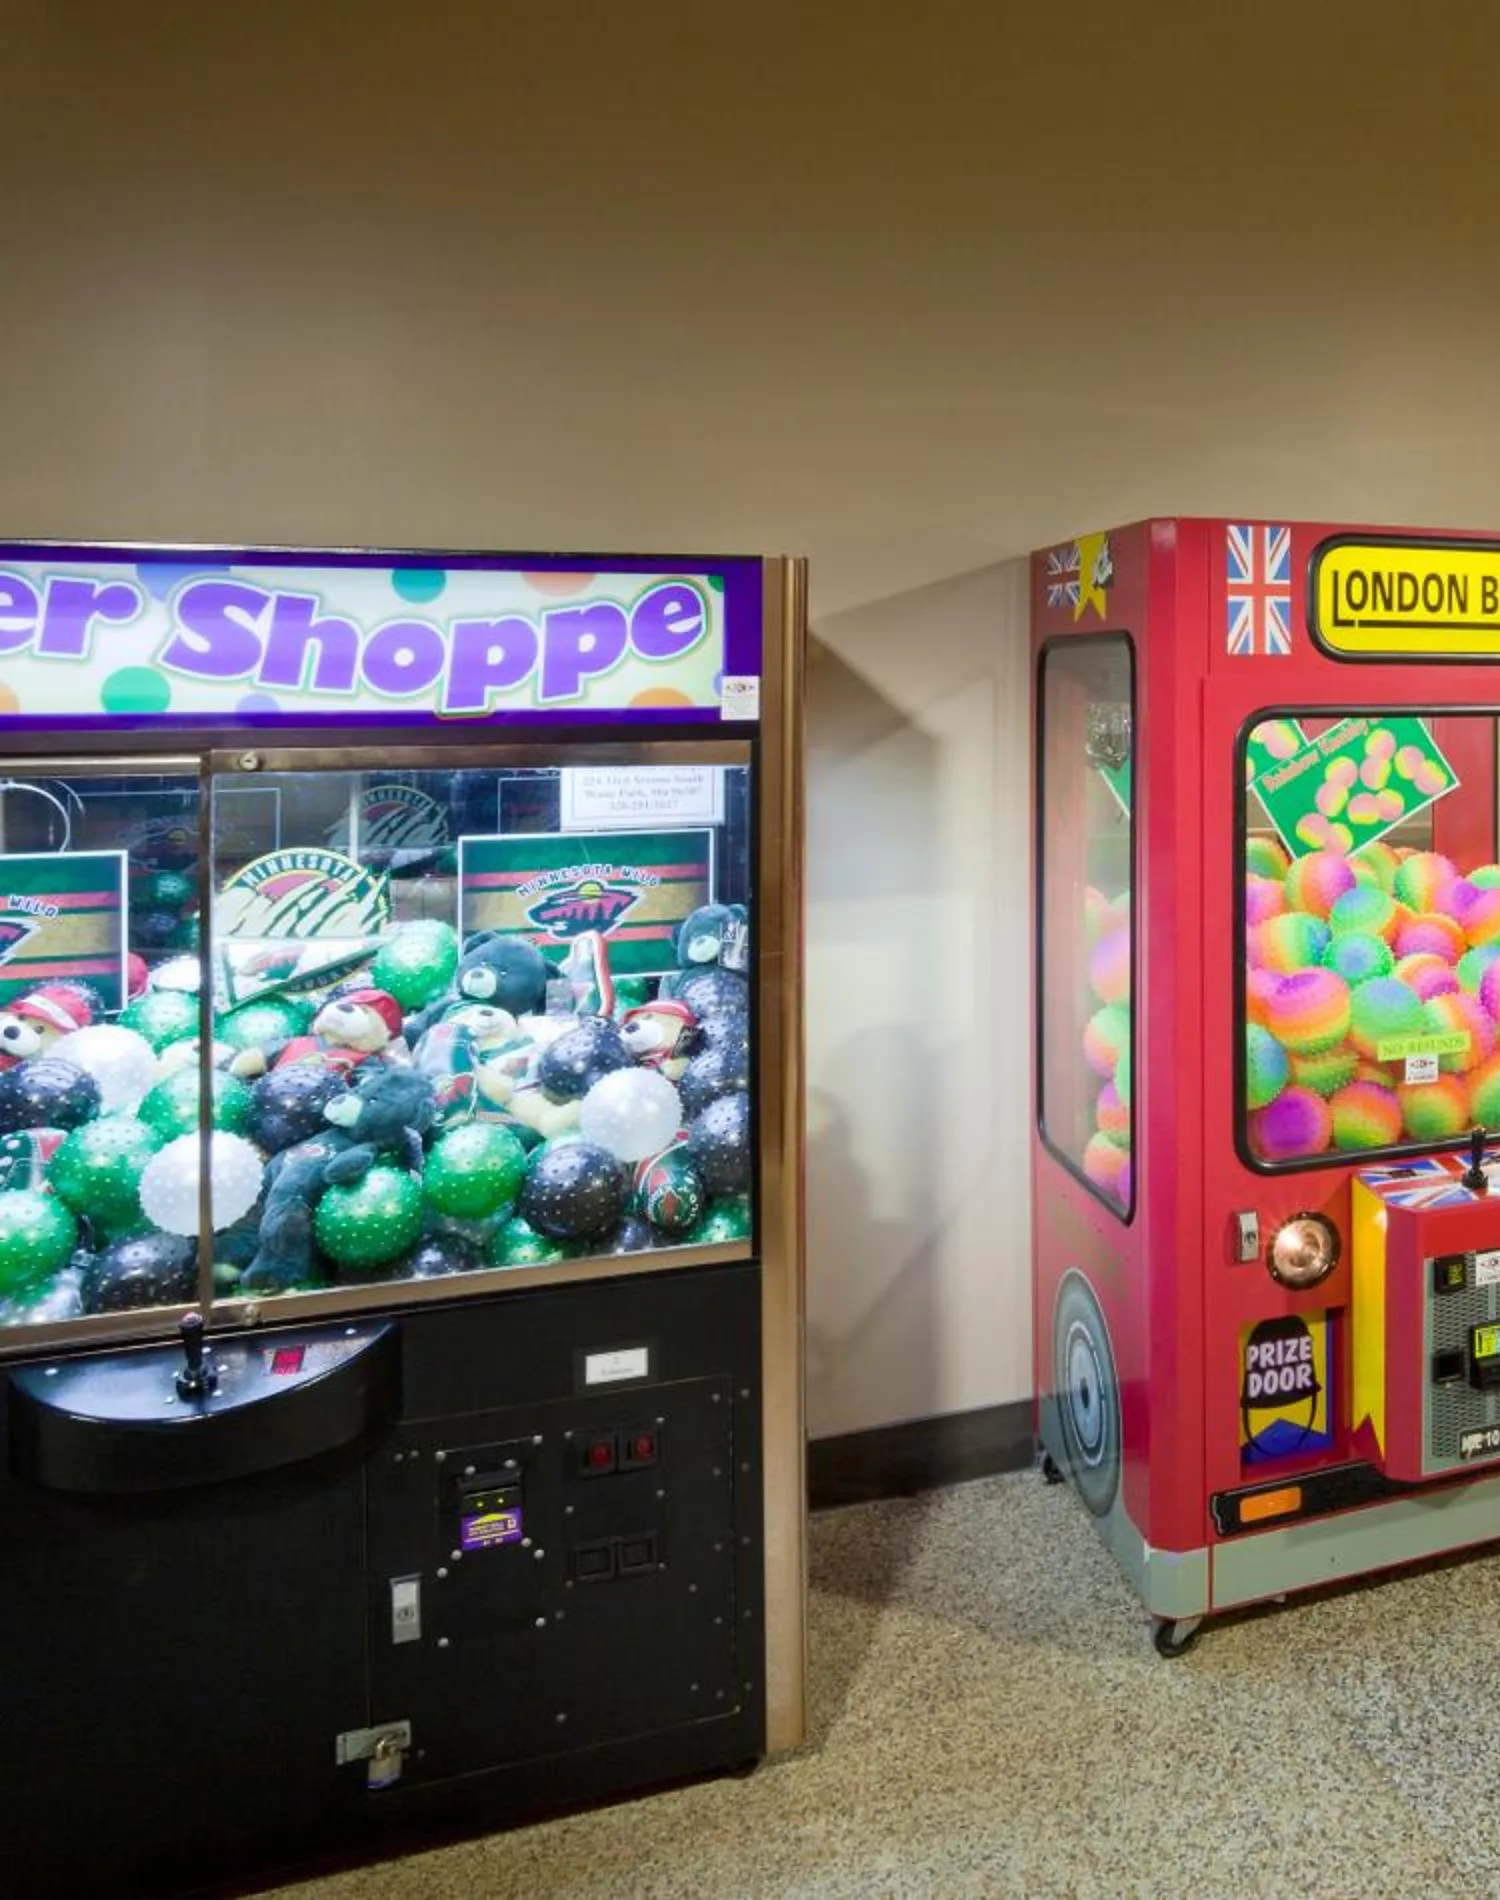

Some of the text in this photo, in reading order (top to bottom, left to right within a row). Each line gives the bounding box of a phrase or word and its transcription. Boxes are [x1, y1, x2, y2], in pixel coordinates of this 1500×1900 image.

[1333, 569, 1468, 628] LONDON
[156, 577, 706, 712] Shoppe
[242, 850, 364, 888] MINNESOTA
[516, 863, 662, 897] MINNESOTA WILD
[7, 893, 59, 919] WILD
[1382, 1042, 1404, 1058] NO
[1246, 1336, 1313, 1371] PRIZE
[1248, 1363, 1313, 1398] DOOR
